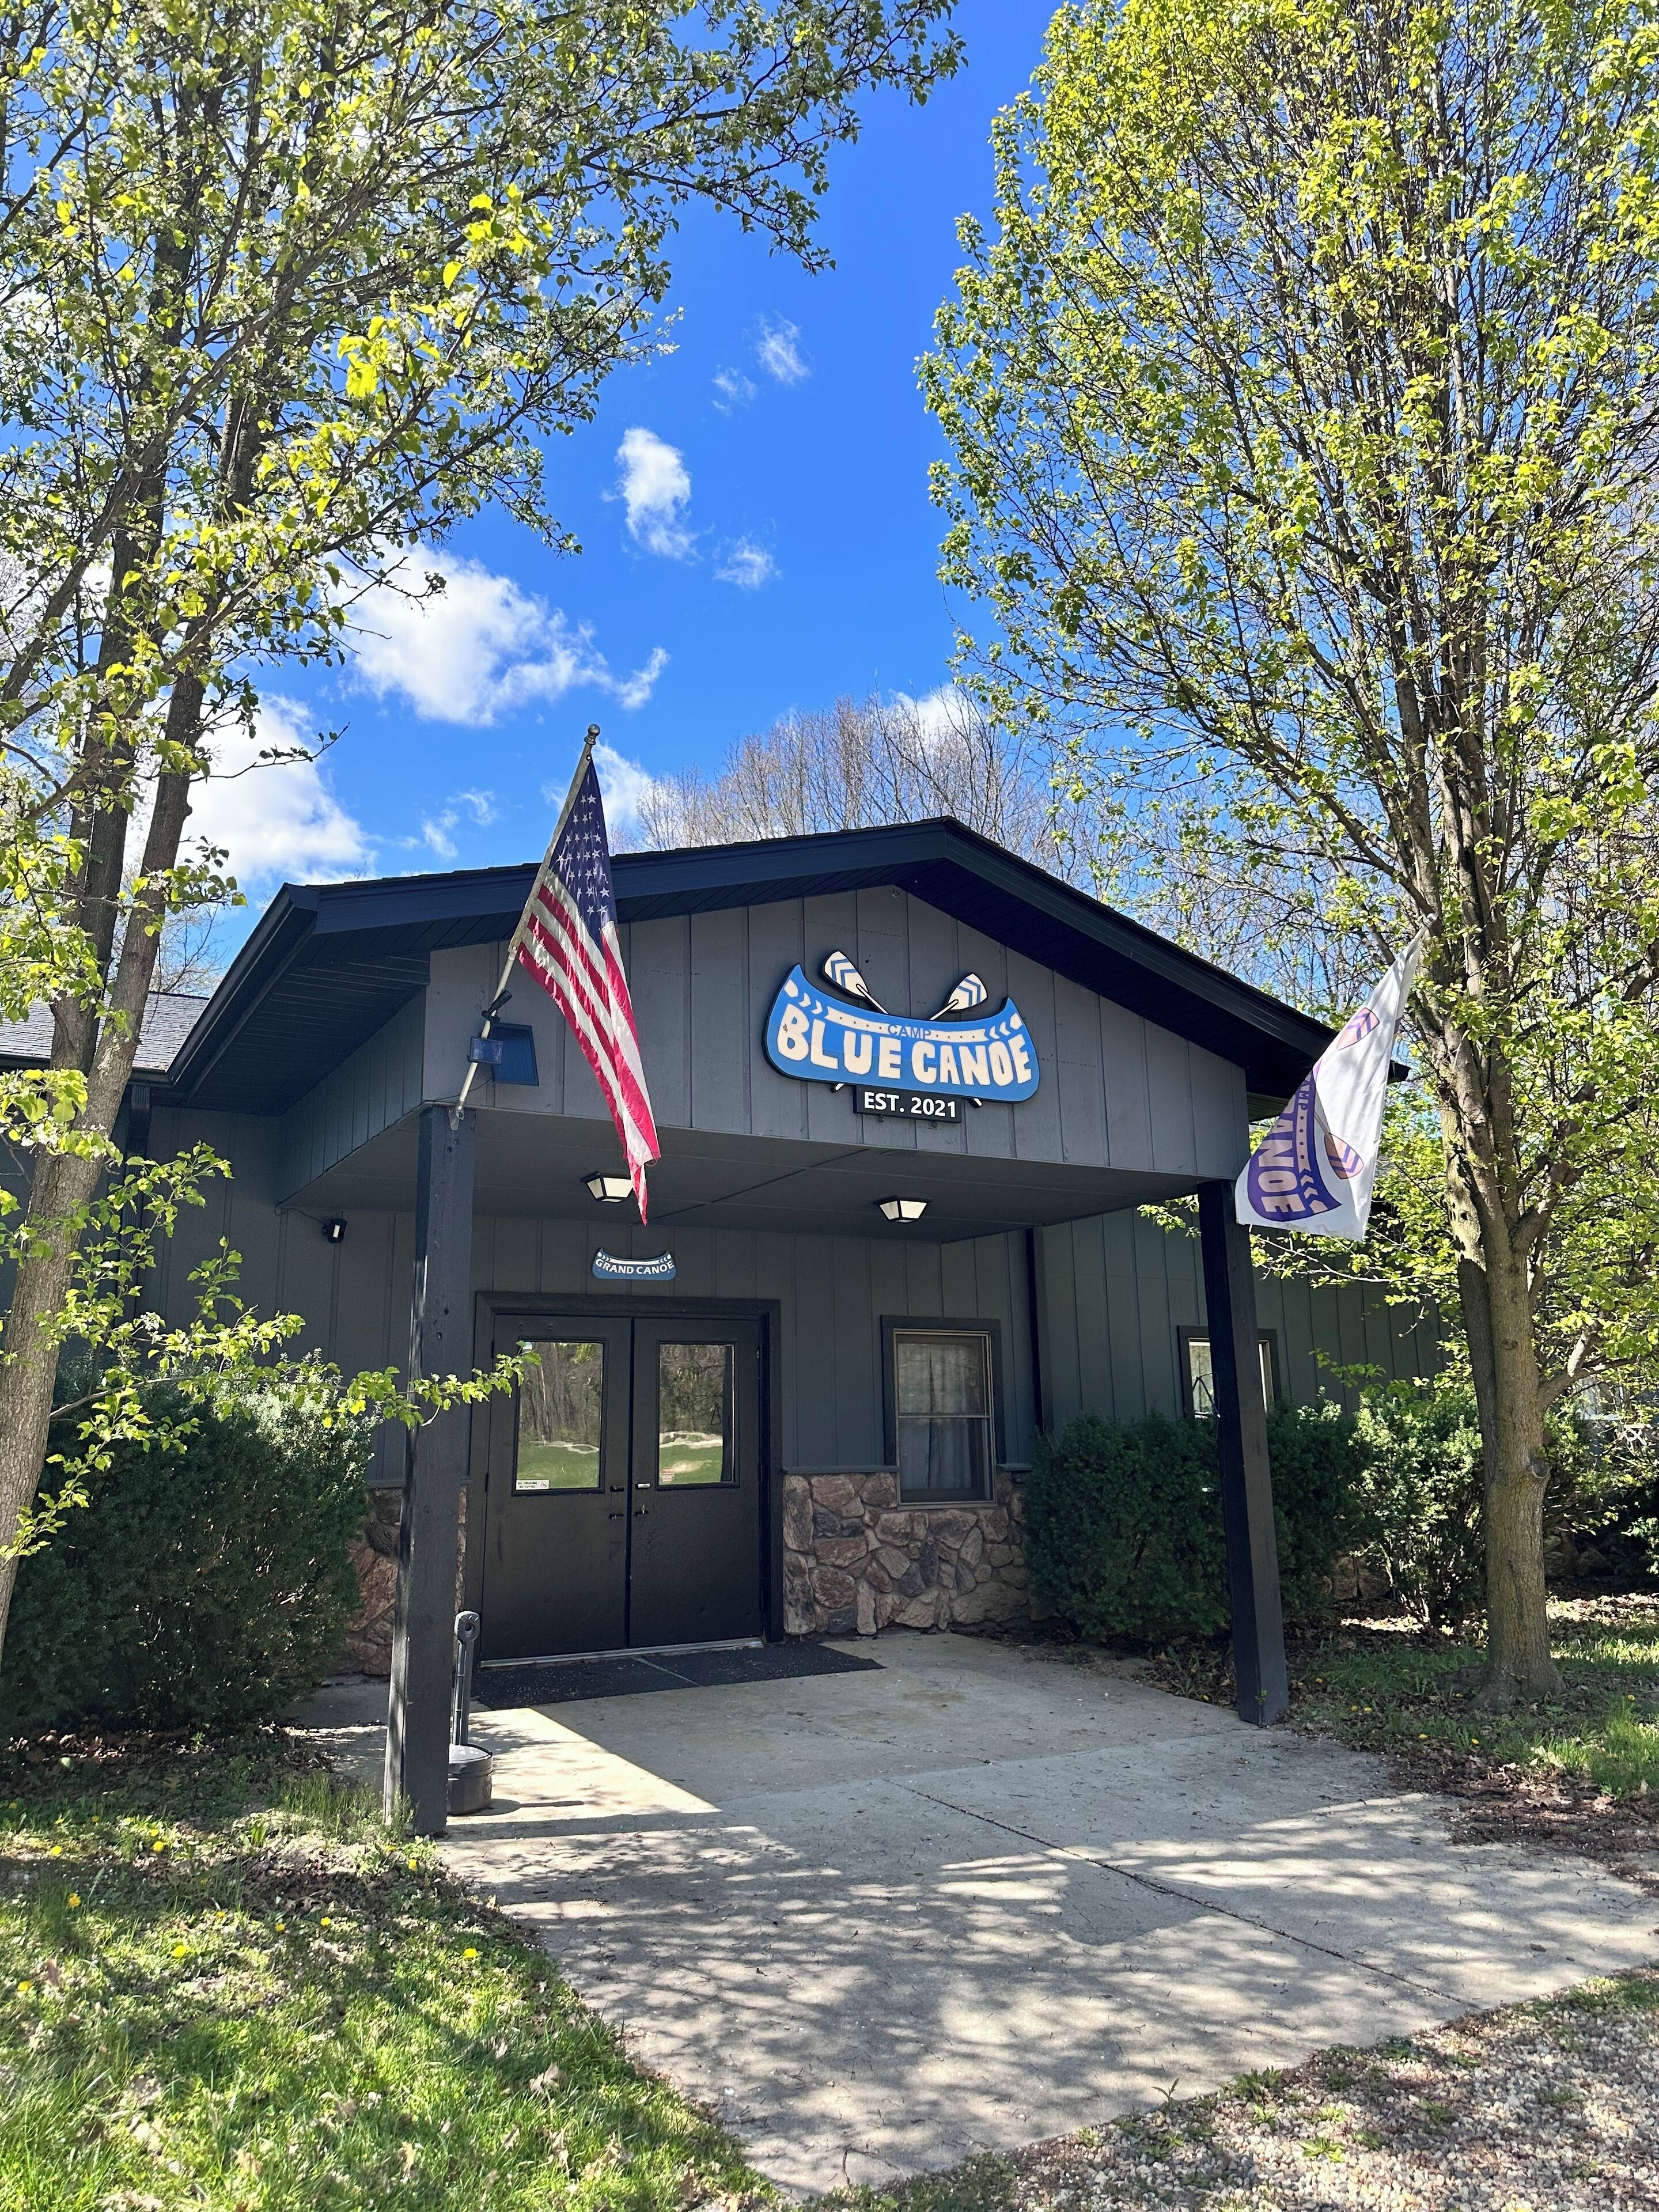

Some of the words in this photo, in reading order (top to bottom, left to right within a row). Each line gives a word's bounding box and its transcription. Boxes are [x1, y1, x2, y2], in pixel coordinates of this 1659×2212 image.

[777, 1003, 902, 1079] BLUE
[911, 1034, 1033, 1086] CANOE
[888, 1024, 931, 1040] CAMP
[864, 1092, 905, 1113] EST.
[911, 1097, 956, 1118] 2021
[1297, 1079, 1310, 1111] AMP
[595, 1259, 634, 1274] GRAND
[636, 1260, 675, 1275] CANOE
